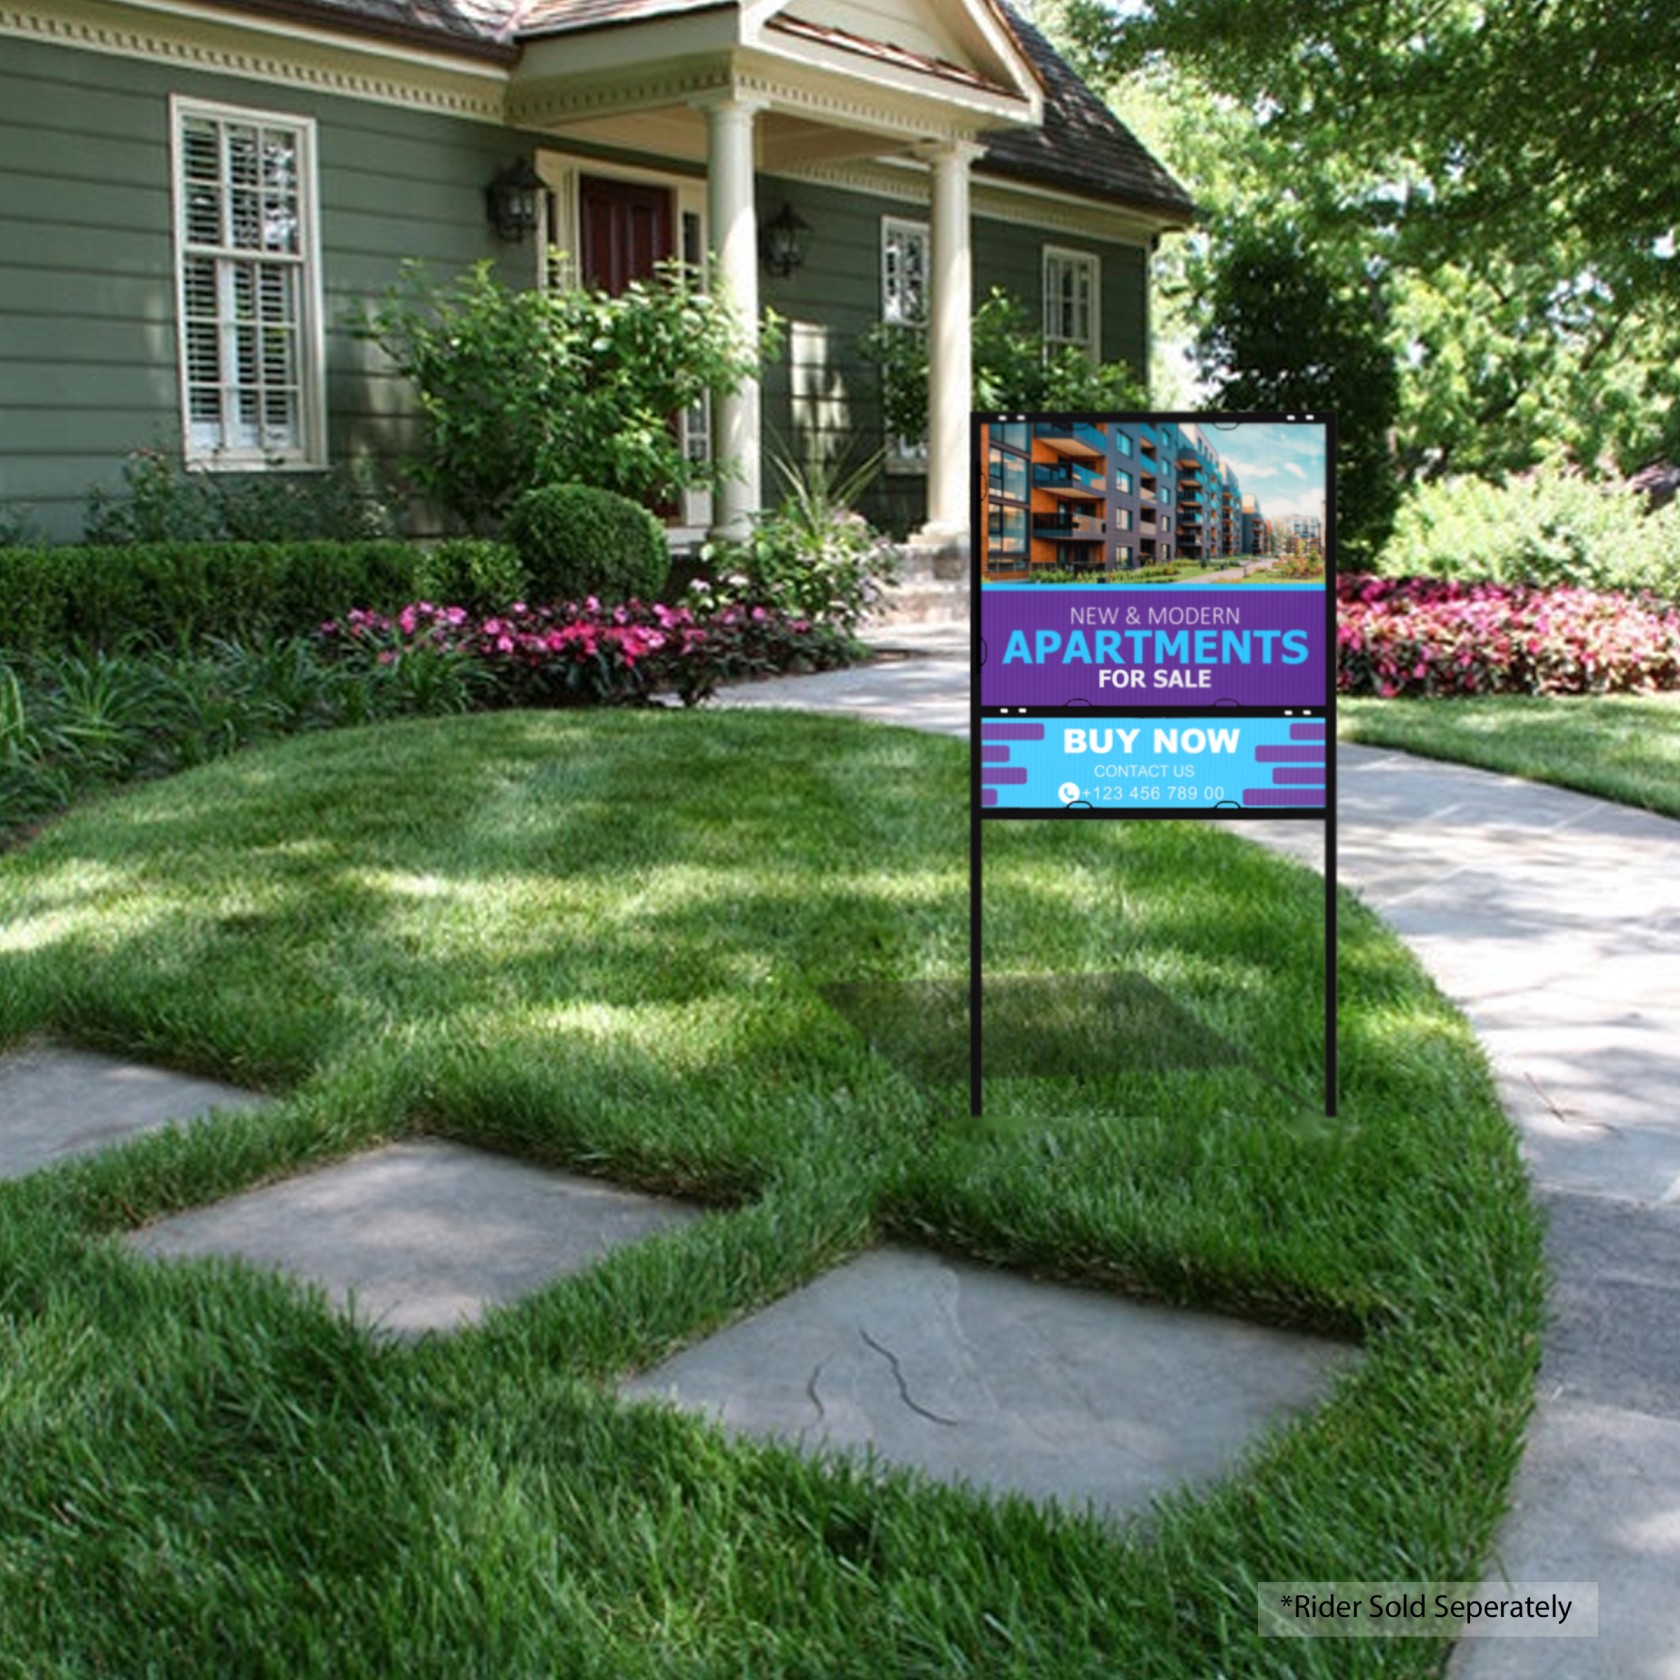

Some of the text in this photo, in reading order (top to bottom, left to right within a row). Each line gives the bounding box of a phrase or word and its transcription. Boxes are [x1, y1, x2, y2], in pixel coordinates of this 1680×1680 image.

[1070, 606, 1240, 625] NEW & MODERN
[1002, 629, 1309, 665] APARTMENTS
[1098, 669, 1212, 688] FOR SALE
[1063, 728, 1240, 754] BUY NOW
[1094, 764, 1195, 779] CONTACT US
[1081, 786, 1224, 801] +123 456 789 00
